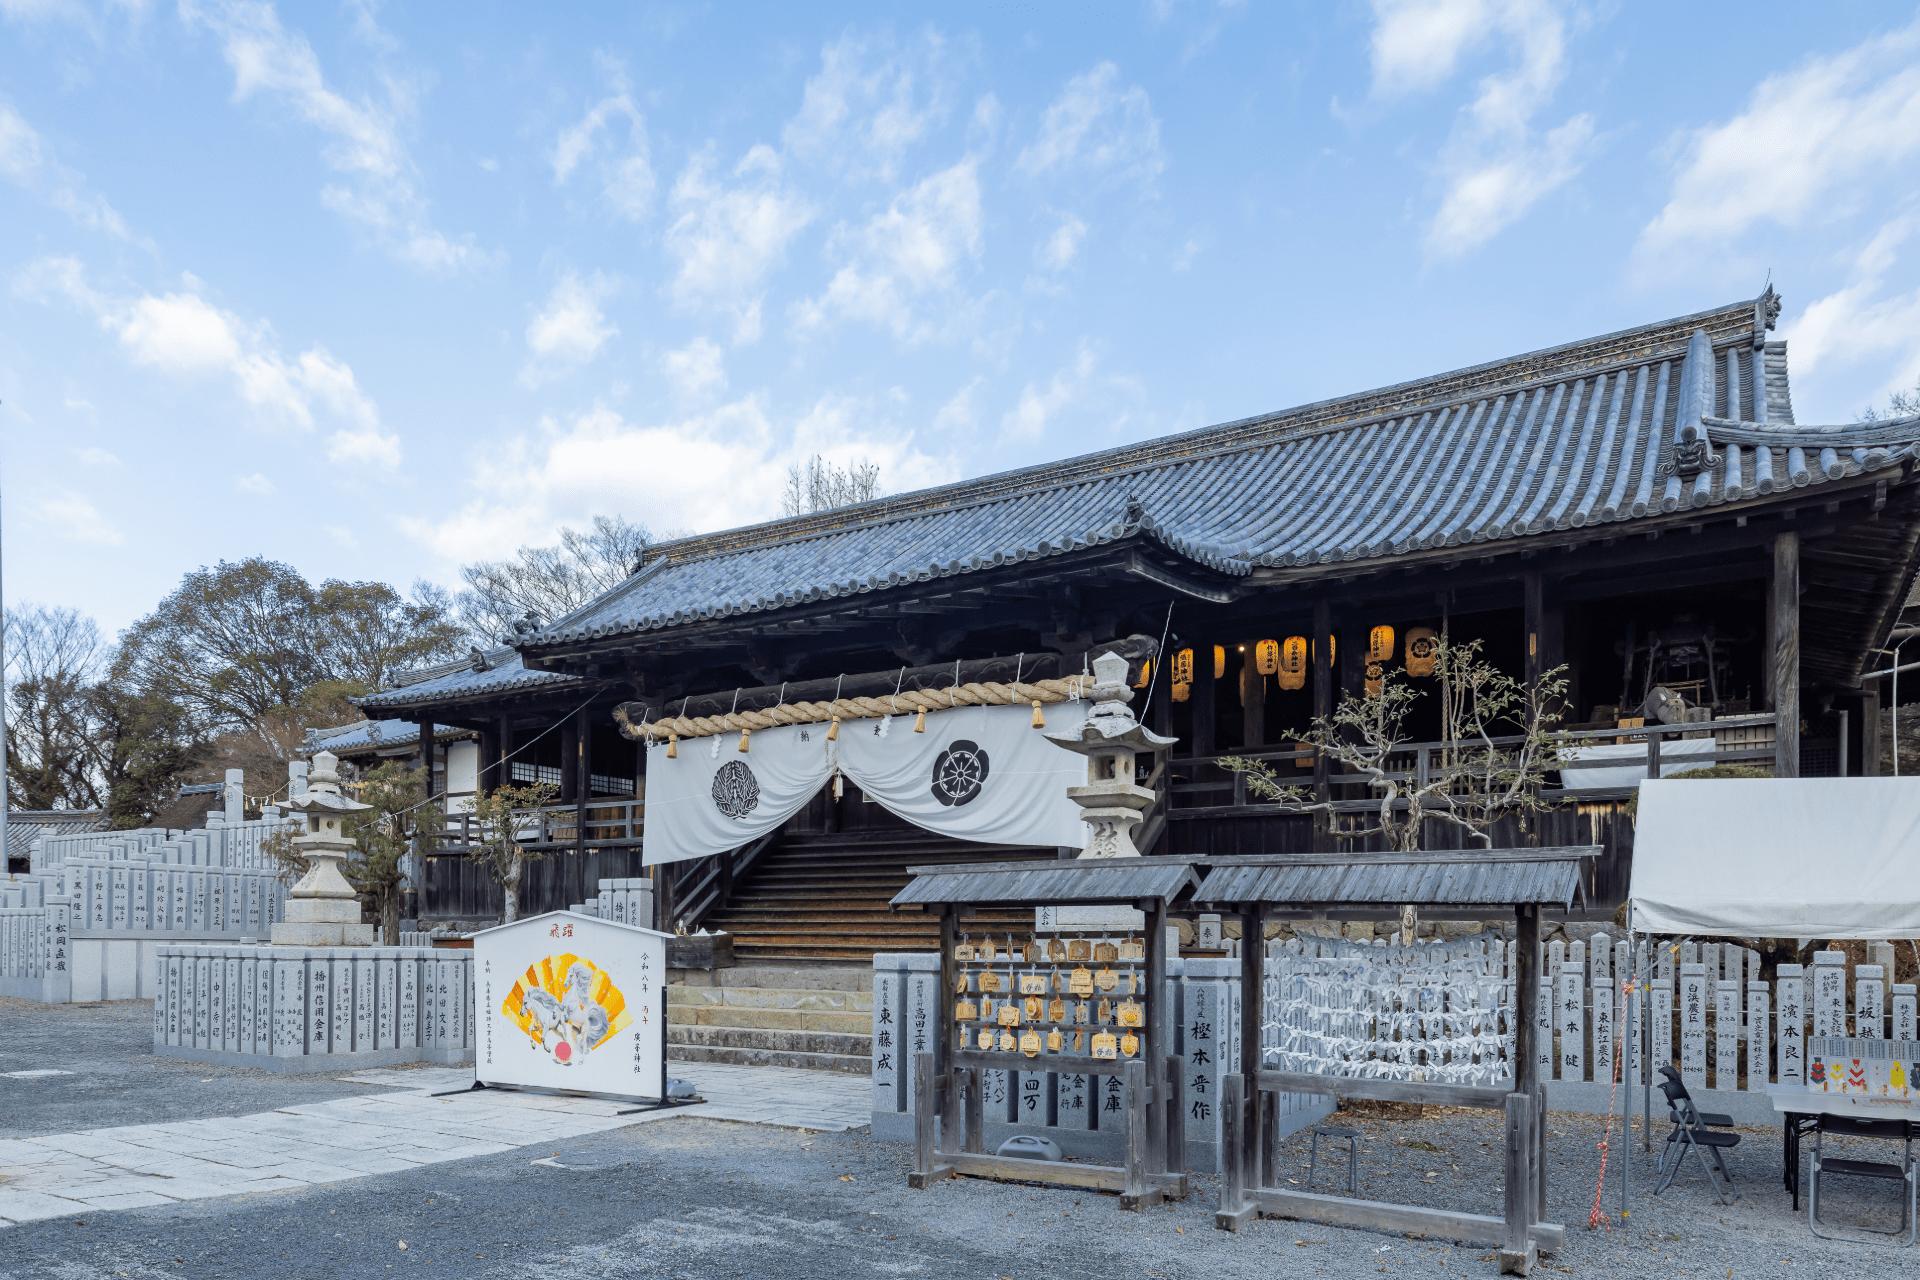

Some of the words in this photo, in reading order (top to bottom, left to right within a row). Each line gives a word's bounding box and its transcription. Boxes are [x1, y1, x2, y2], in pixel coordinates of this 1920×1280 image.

[549, 923, 575, 938] 飛躍
[640, 952, 650, 993] 令和八年
[1830, 972, 1839, 992] 花田町
[313, 970, 327, 1042] 播州信用金庫
[641, 1005, 649, 1025] 丙午
[1858, 1006, 1876, 1039] 坂越
[877, 1007, 894, 1087] 東藤成一
[914, 1008, 926, 1052] 高田工業
[1564, 999, 1580, 1068] 松本健
[1782, 1004, 1800, 1078] 濱本良二
[1071, 1074, 1086, 1110] 金庫
[1104, 1075, 1125, 1114] 金庫
